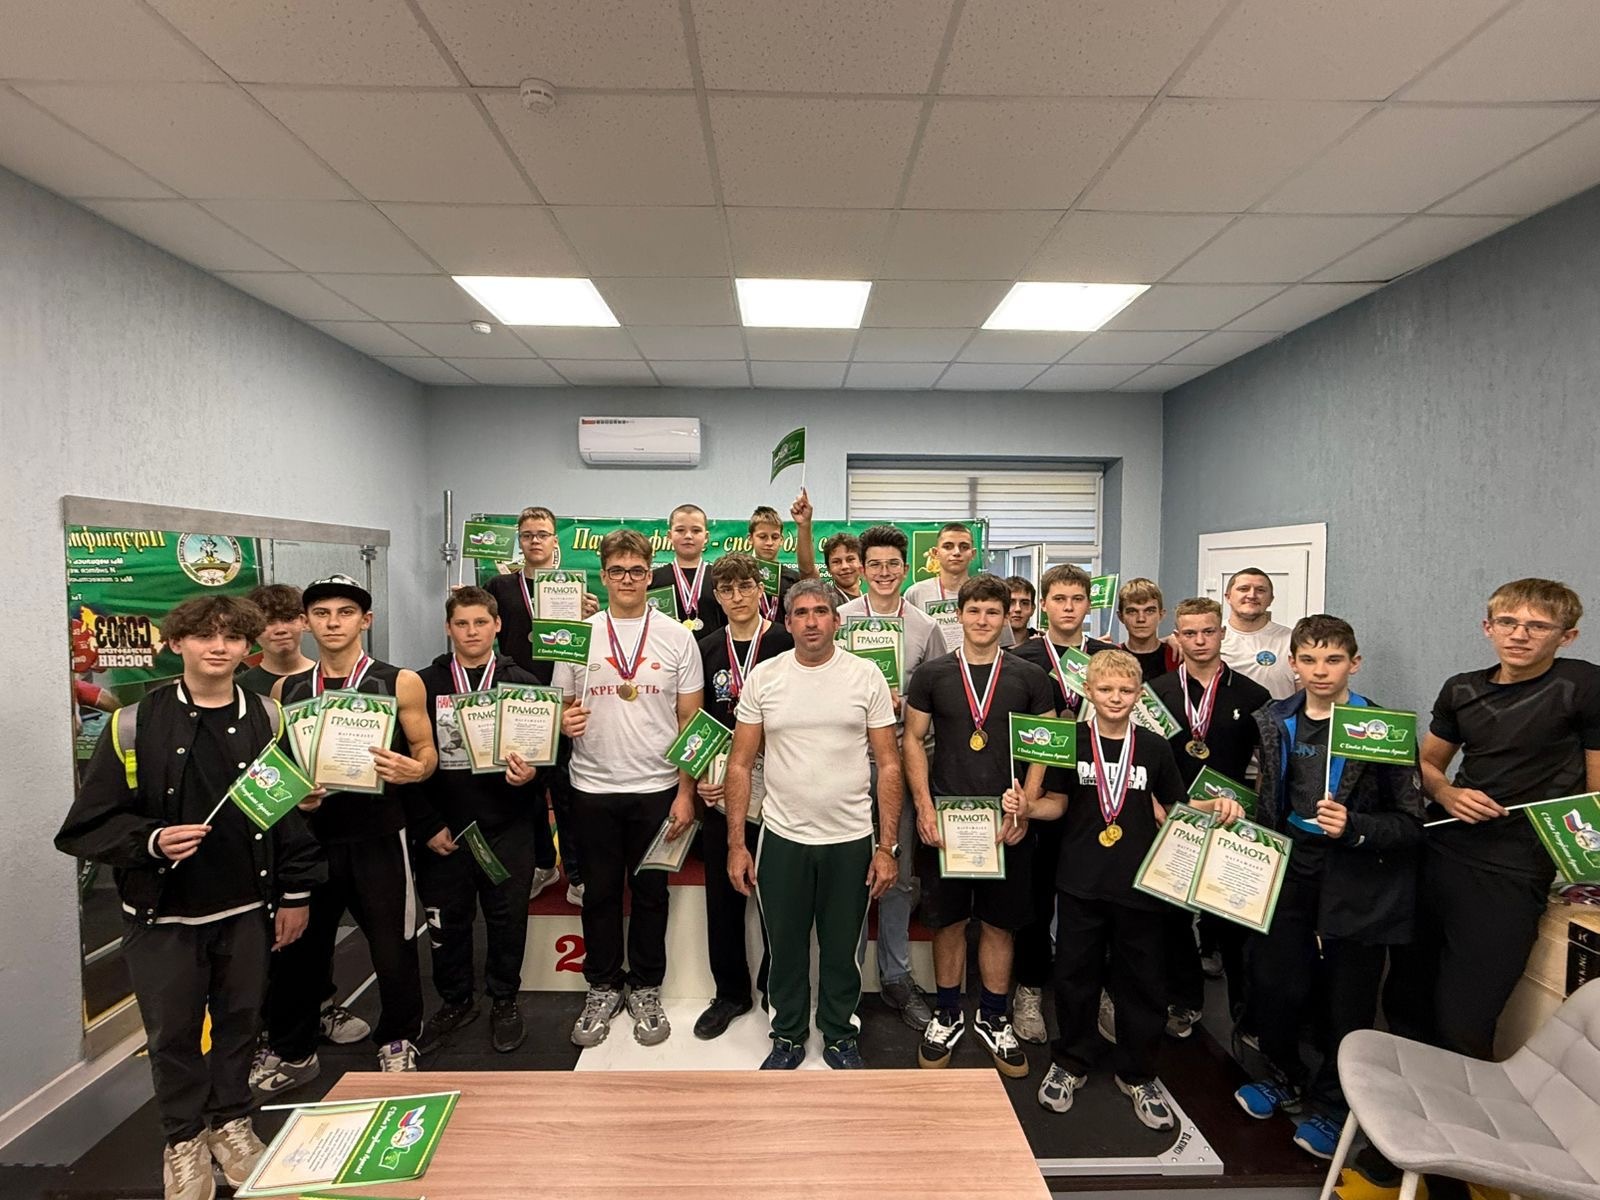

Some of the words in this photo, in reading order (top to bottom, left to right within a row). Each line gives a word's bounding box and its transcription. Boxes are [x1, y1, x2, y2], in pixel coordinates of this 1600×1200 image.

[543, 586, 578, 594] ГРАМОТА
[936, 617, 960, 625] ГРАМО
[857, 636, 894, 644] ГРАМОТА
[507, 705, 550, 716] ГРАМОТА
[330, 716, 381, 729] ГРАМОТА
[948, 814, 990, 822] ГРАМОТА
[1217, 837, 1271, 865] ГРАМОТА
[555, 934, 586, 973] 2
